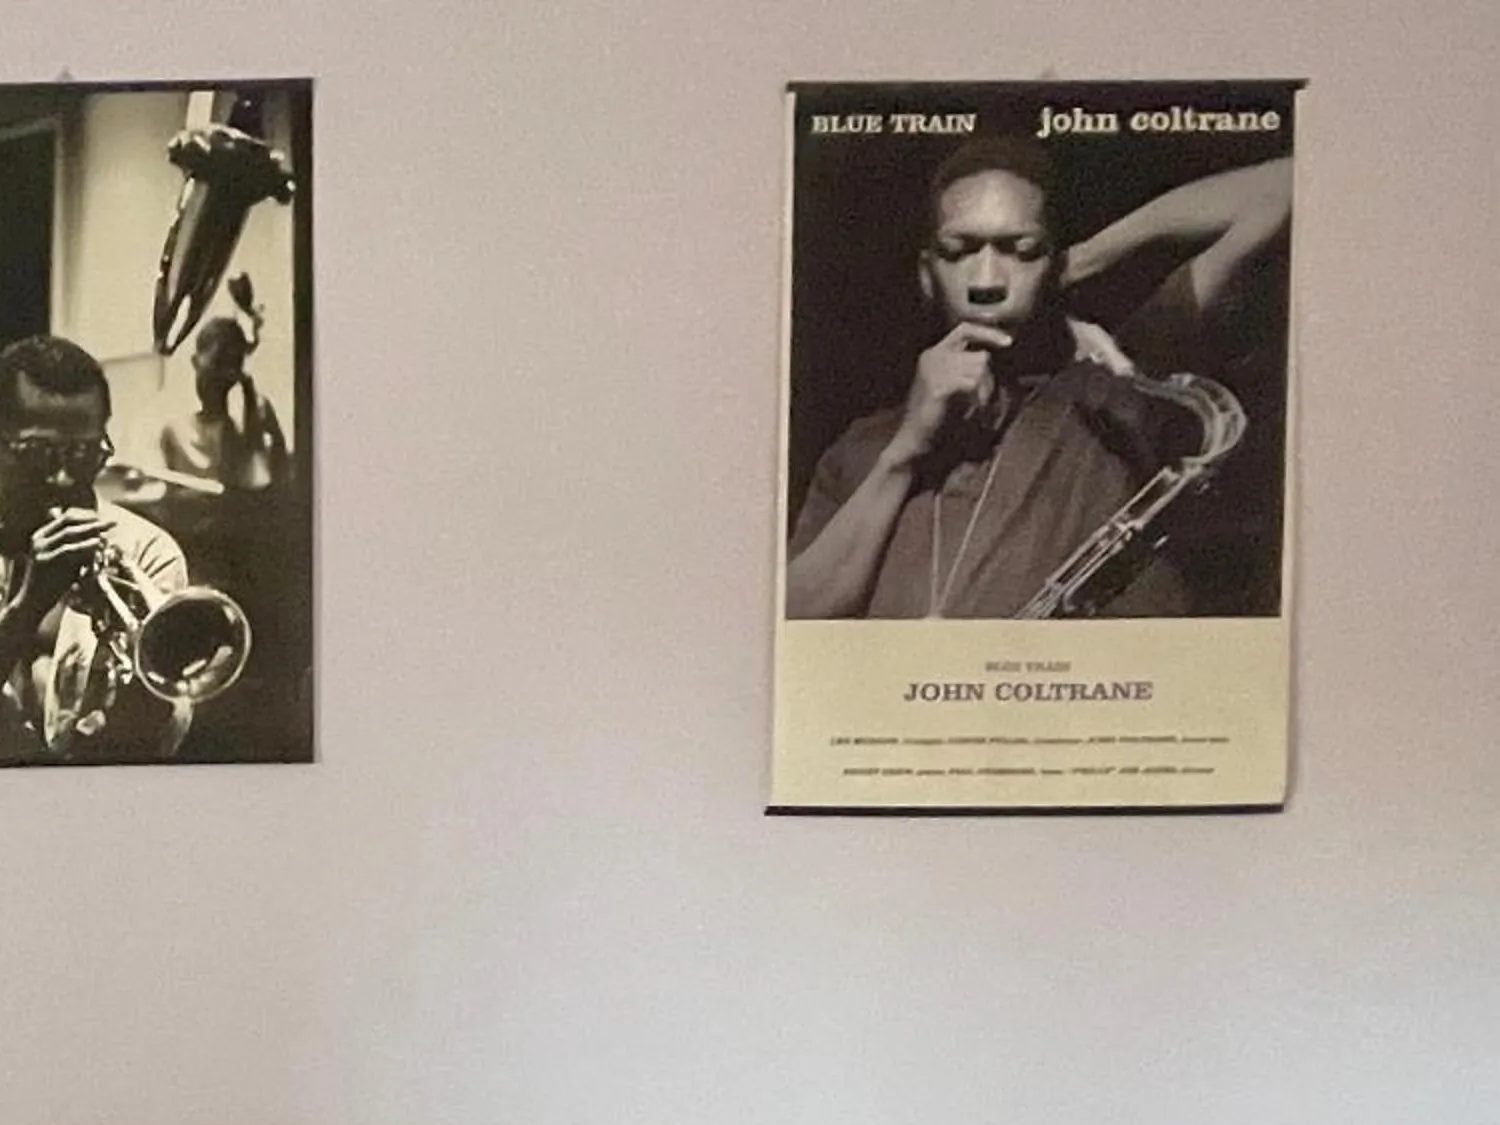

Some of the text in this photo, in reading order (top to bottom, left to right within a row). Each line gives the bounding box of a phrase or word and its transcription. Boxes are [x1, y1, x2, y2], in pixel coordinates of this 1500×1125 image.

[811, 113, 977, 134] BLUE TRAIN
[1037, 106, 1281, 138] john coltrane
[903, 681, 1154, 702] JOHN COLTRANE
